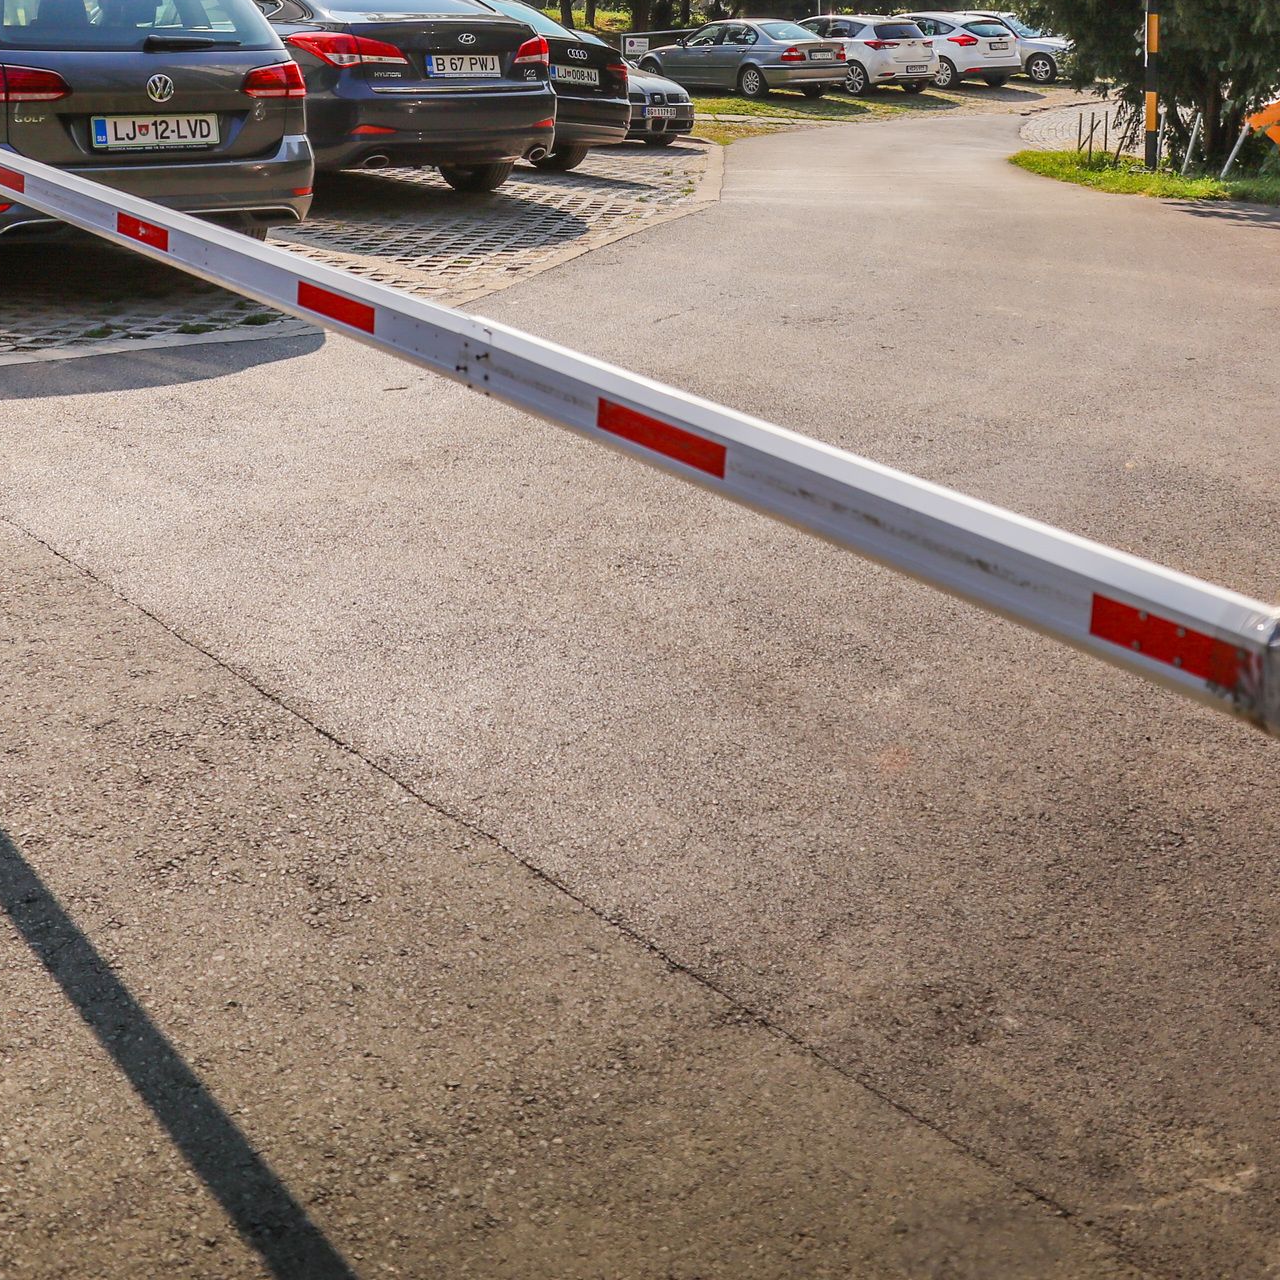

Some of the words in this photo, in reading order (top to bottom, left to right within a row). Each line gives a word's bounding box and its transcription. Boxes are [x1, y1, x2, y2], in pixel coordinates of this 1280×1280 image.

[435, 58, 446, 71] B
[450, 58, 464, 71] 67
[470, 57, 496, 71] PWJ
[556, 67, 567, 79] LJ
[14, 114, 45, 123] GOLF
[113, 120, 137, 141] LJ
[151, 119, 211, 140] 12-LVD
